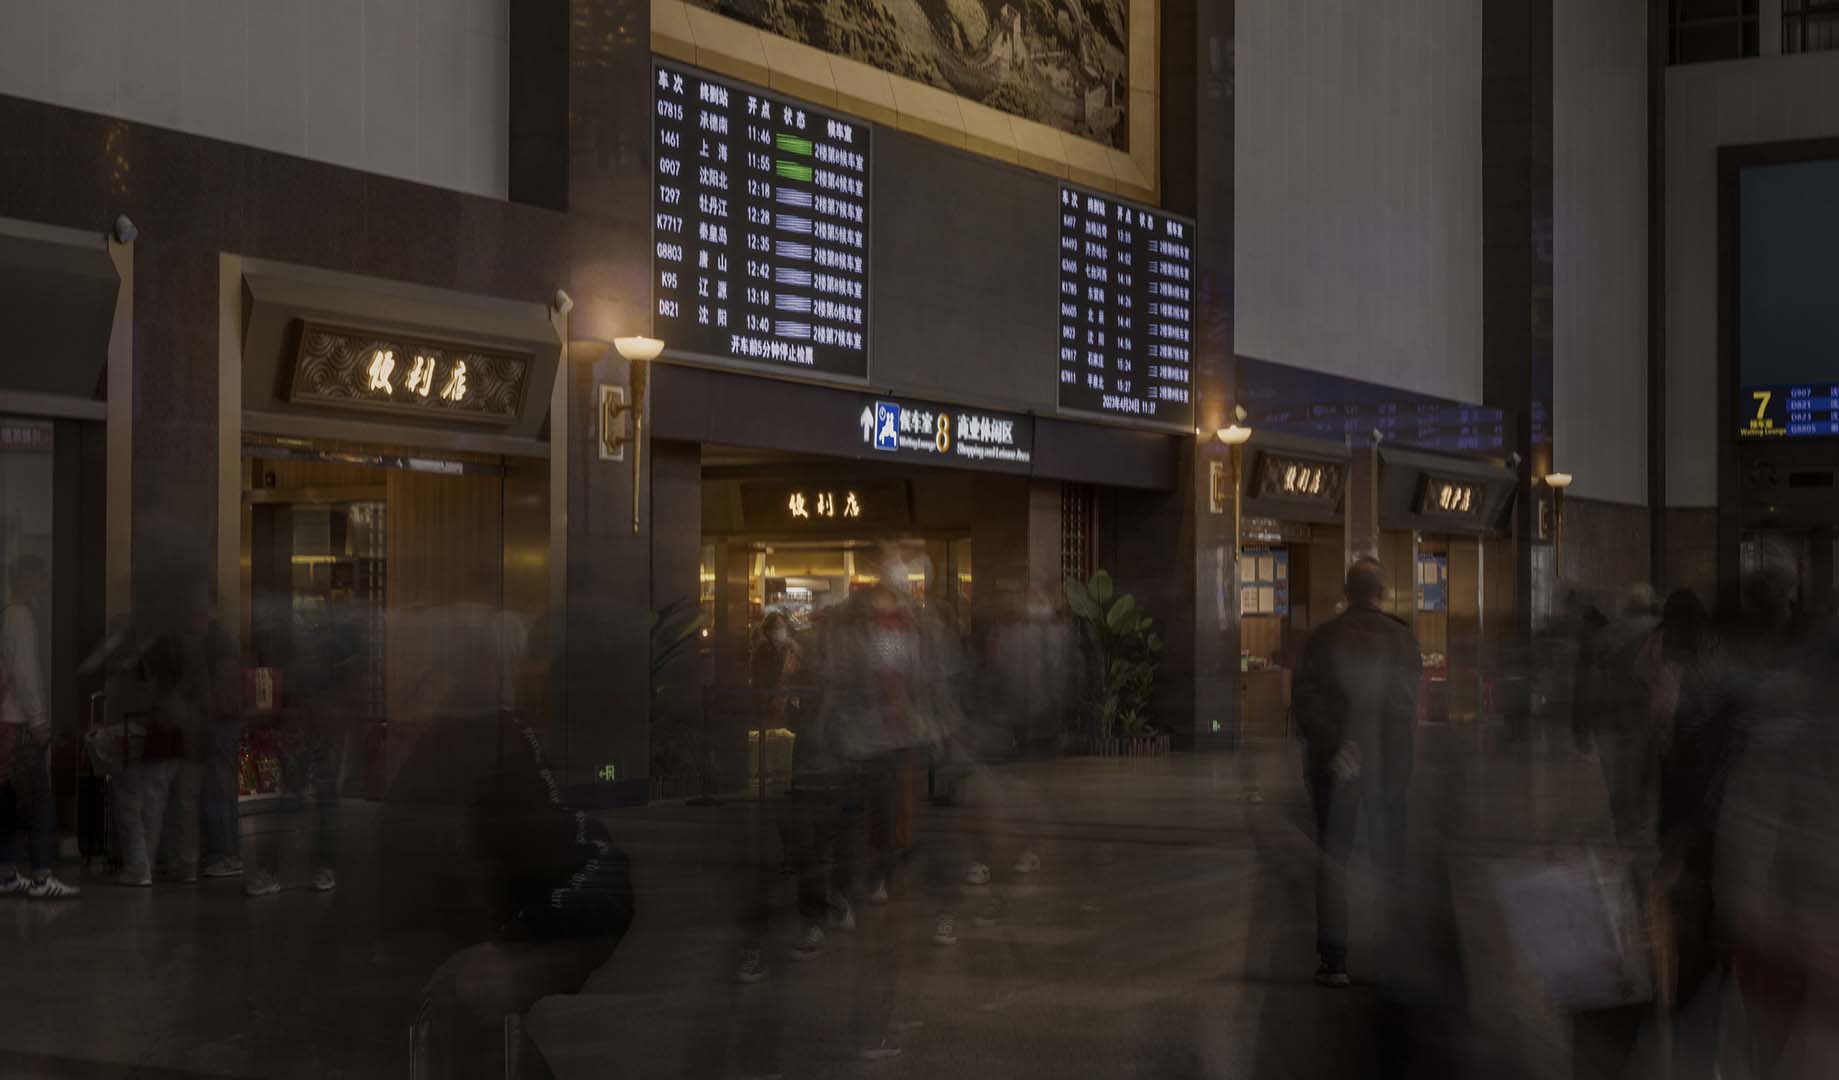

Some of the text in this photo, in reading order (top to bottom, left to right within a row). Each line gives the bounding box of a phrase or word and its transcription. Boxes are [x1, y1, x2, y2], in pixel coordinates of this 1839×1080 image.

[657, 99, 684, 121] G7815
[748, 125, 771, 145] 11:46
[660, 129, 680, 149] 1461
[699, 138, 728, 163] 上海
[748, 151, 771, 172] 11:55
[659, 157, 681, 177] G907
[699, 167, 729, 191] 沈阳北
[660, 185, 681, 205] T297
[699, 193, 728, 217] 牡丹江
[656, 213, 683, 234] K7717
[699, 221, 728, 246] 秦皇岛
[747, 233, 770, 252] 12:35
[661, 271, 678, 289] K95
[698, 249, 727, 273] 唐山
[747, 260, 770, 280] 12:42
[659, 299, 679, 319] D821
[698, 305, 727, 327] 沈阳
[747, 314, 769, 333] 13:40
[367, 348, 467, 401] 便利店
[1752, 390, 1772, 420] 7
[900, 407, 1014, 453] 候车室 8 商业休闲区
[789, 491, 860, 519] 便利店
